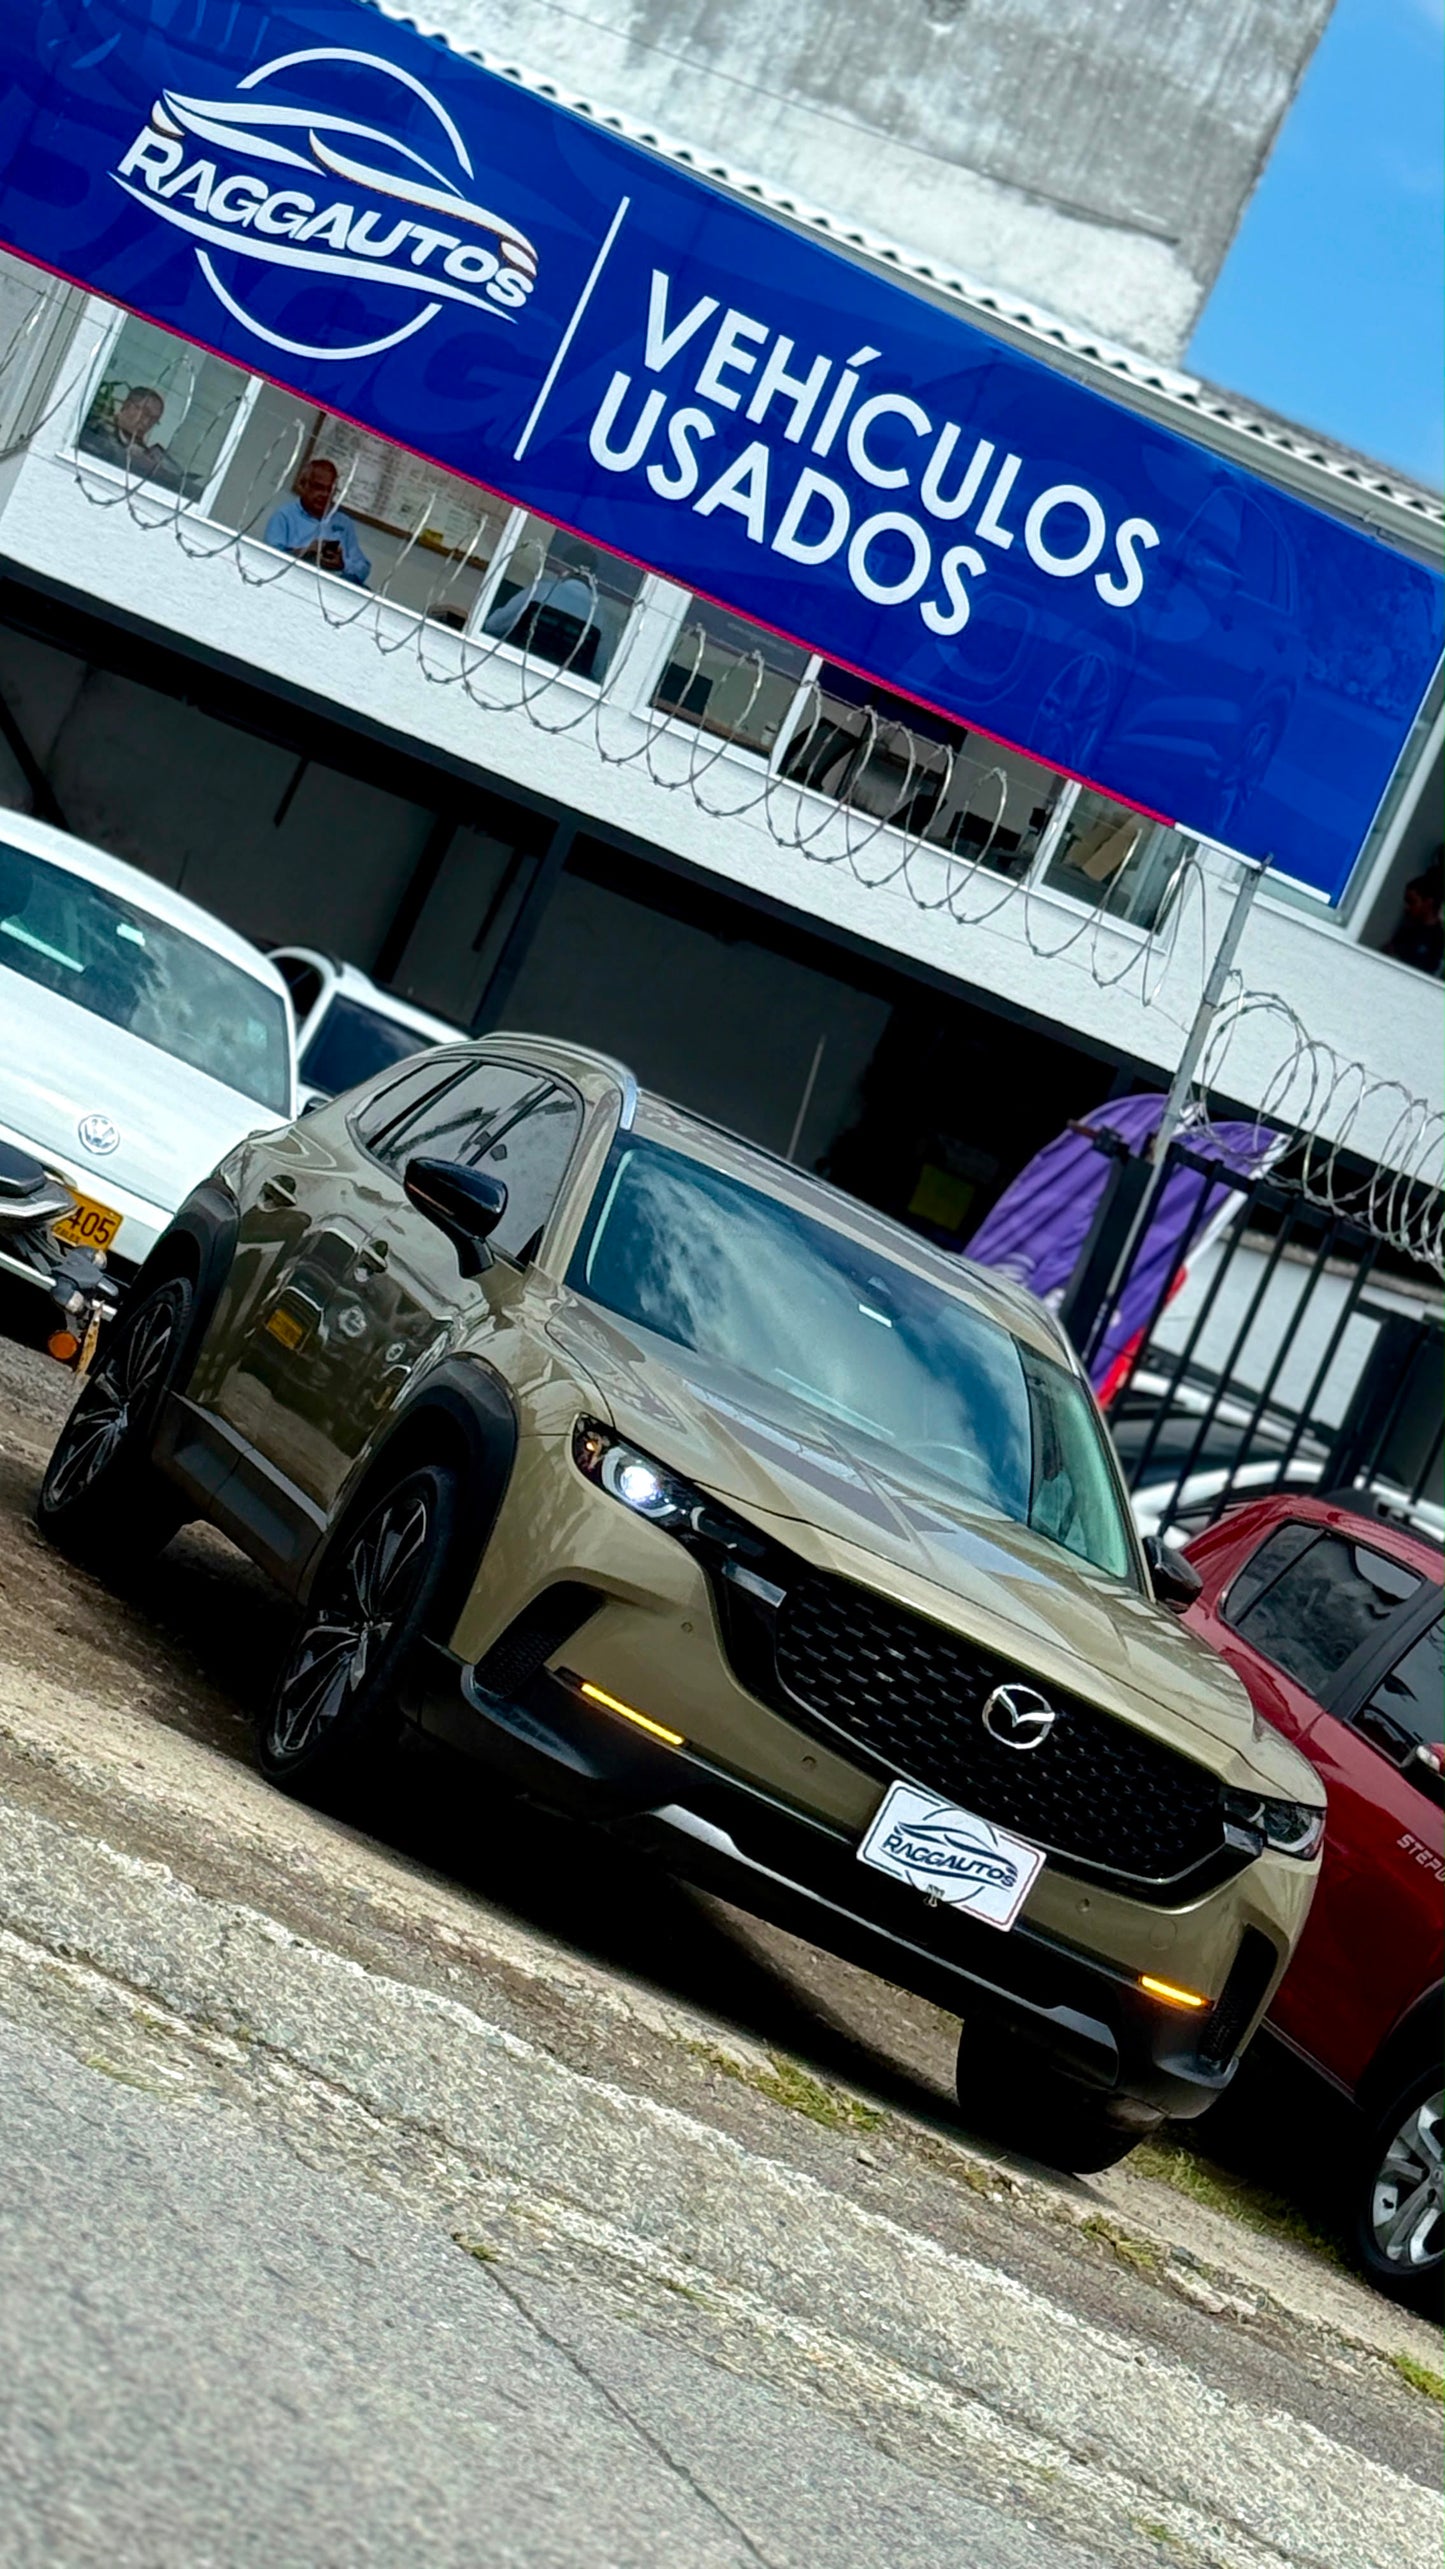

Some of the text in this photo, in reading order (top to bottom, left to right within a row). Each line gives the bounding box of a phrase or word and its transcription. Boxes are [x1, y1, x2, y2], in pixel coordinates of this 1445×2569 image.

[117, 125, 535, 309] RAGGAUTOS
[588, 370, 987, 637] USADOS
[645, 268, 1161, 608] VEHÍCULOS
[881, 1834, 1018, 1888] RAGGAUTOS
